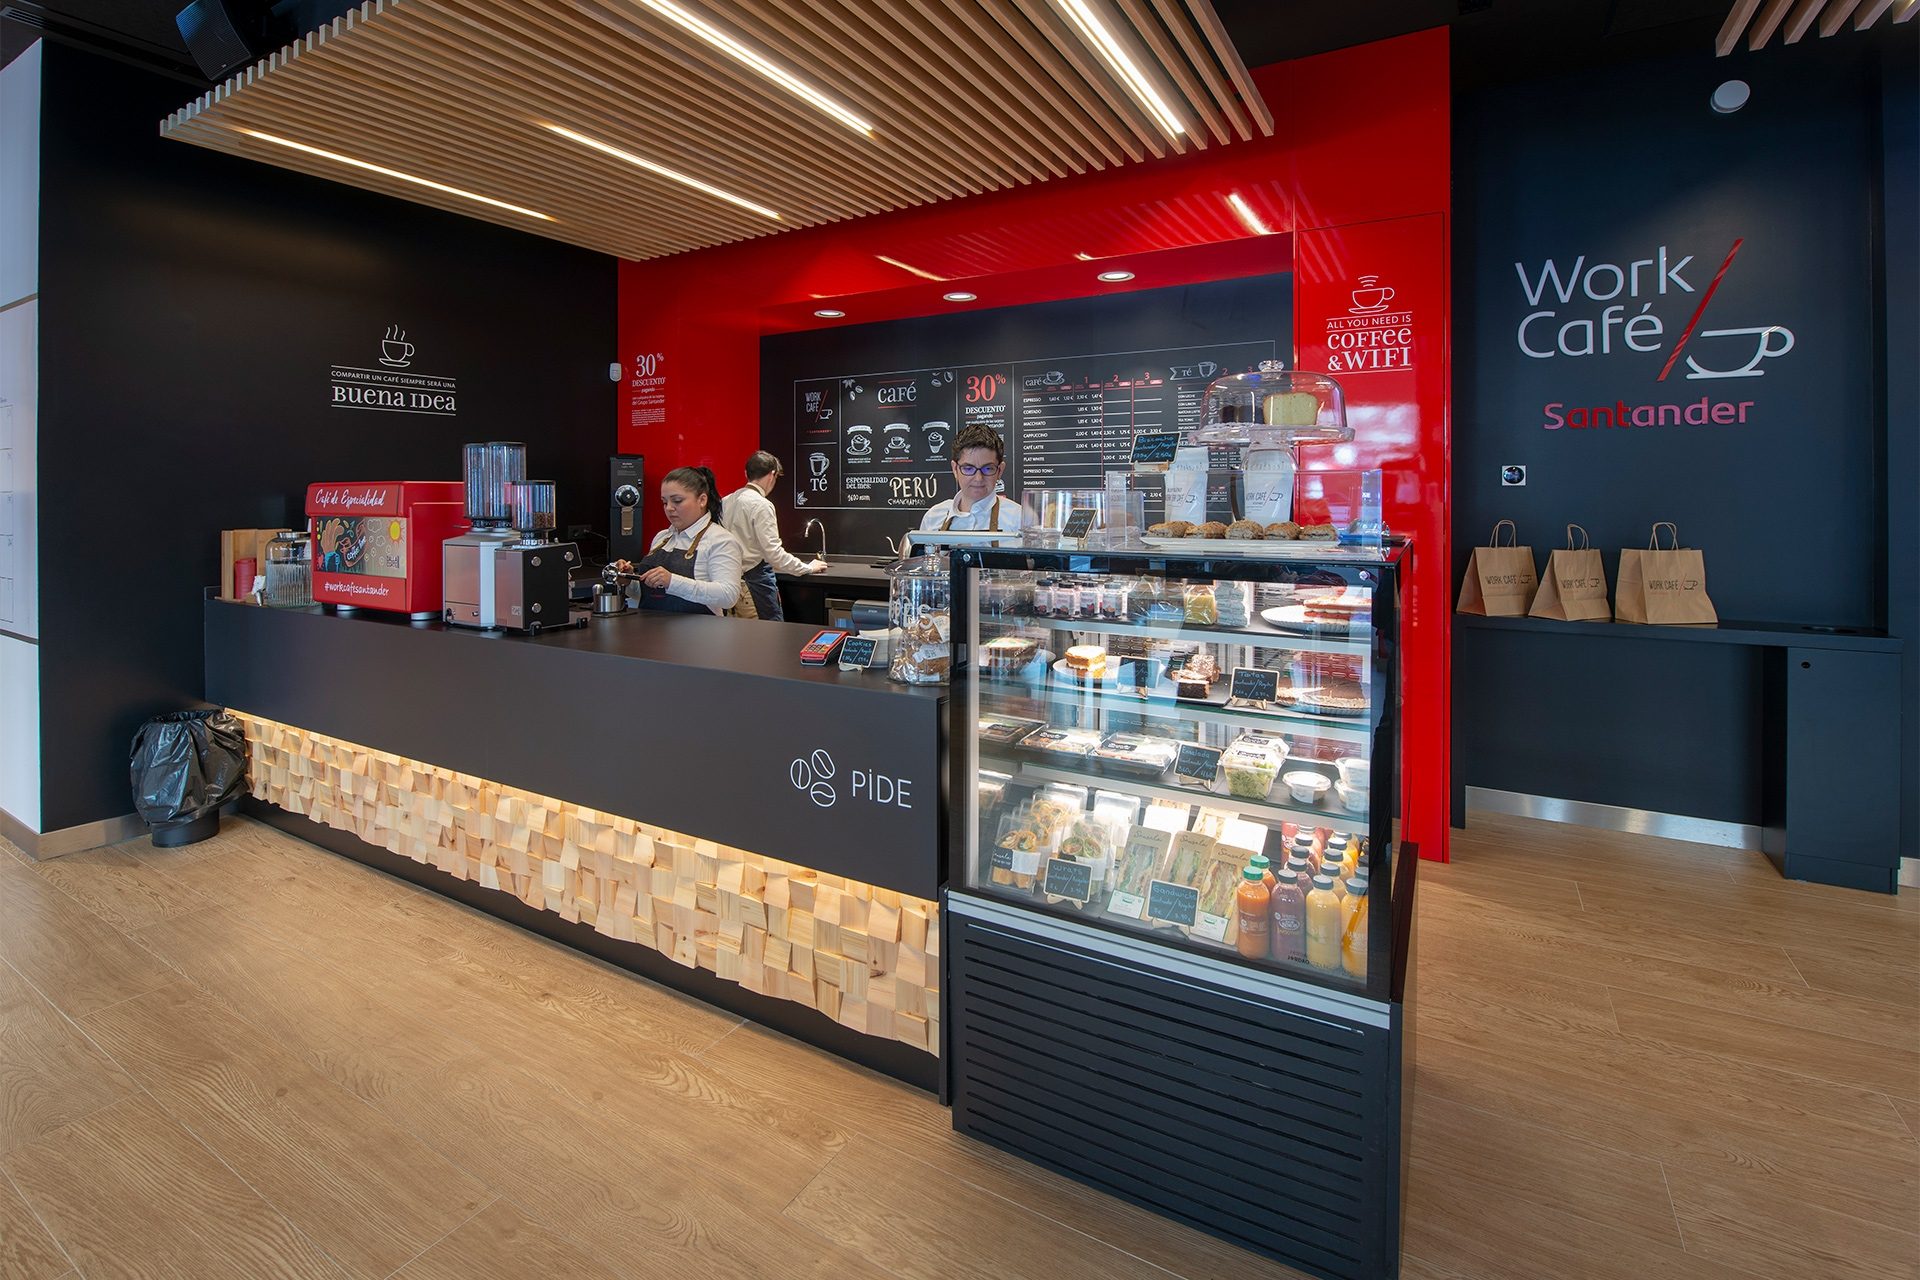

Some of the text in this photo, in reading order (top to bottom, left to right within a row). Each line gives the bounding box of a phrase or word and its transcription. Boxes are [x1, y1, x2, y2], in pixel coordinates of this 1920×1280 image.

[1515, 246, 1695, 306] Work
[1327, 314, 1412, 330] ALL YOU NEED IS
[1518, 302, 1664, 358] Café
[331, 371, 370, 380] COMPARTIR
[636, 352, 664, 377] 30%
[805, 392, 821, 402] WORK
[966, 374, 1006, 402] 30%
[1544, 397, 1754, 430] Santander
[889, 474, 937, 498] PERÚ
[341, 489, 386, 509] Especialidad
[1485, 576, 1503, 584] WORK
[1648, 580, 1664, 590] WORK
